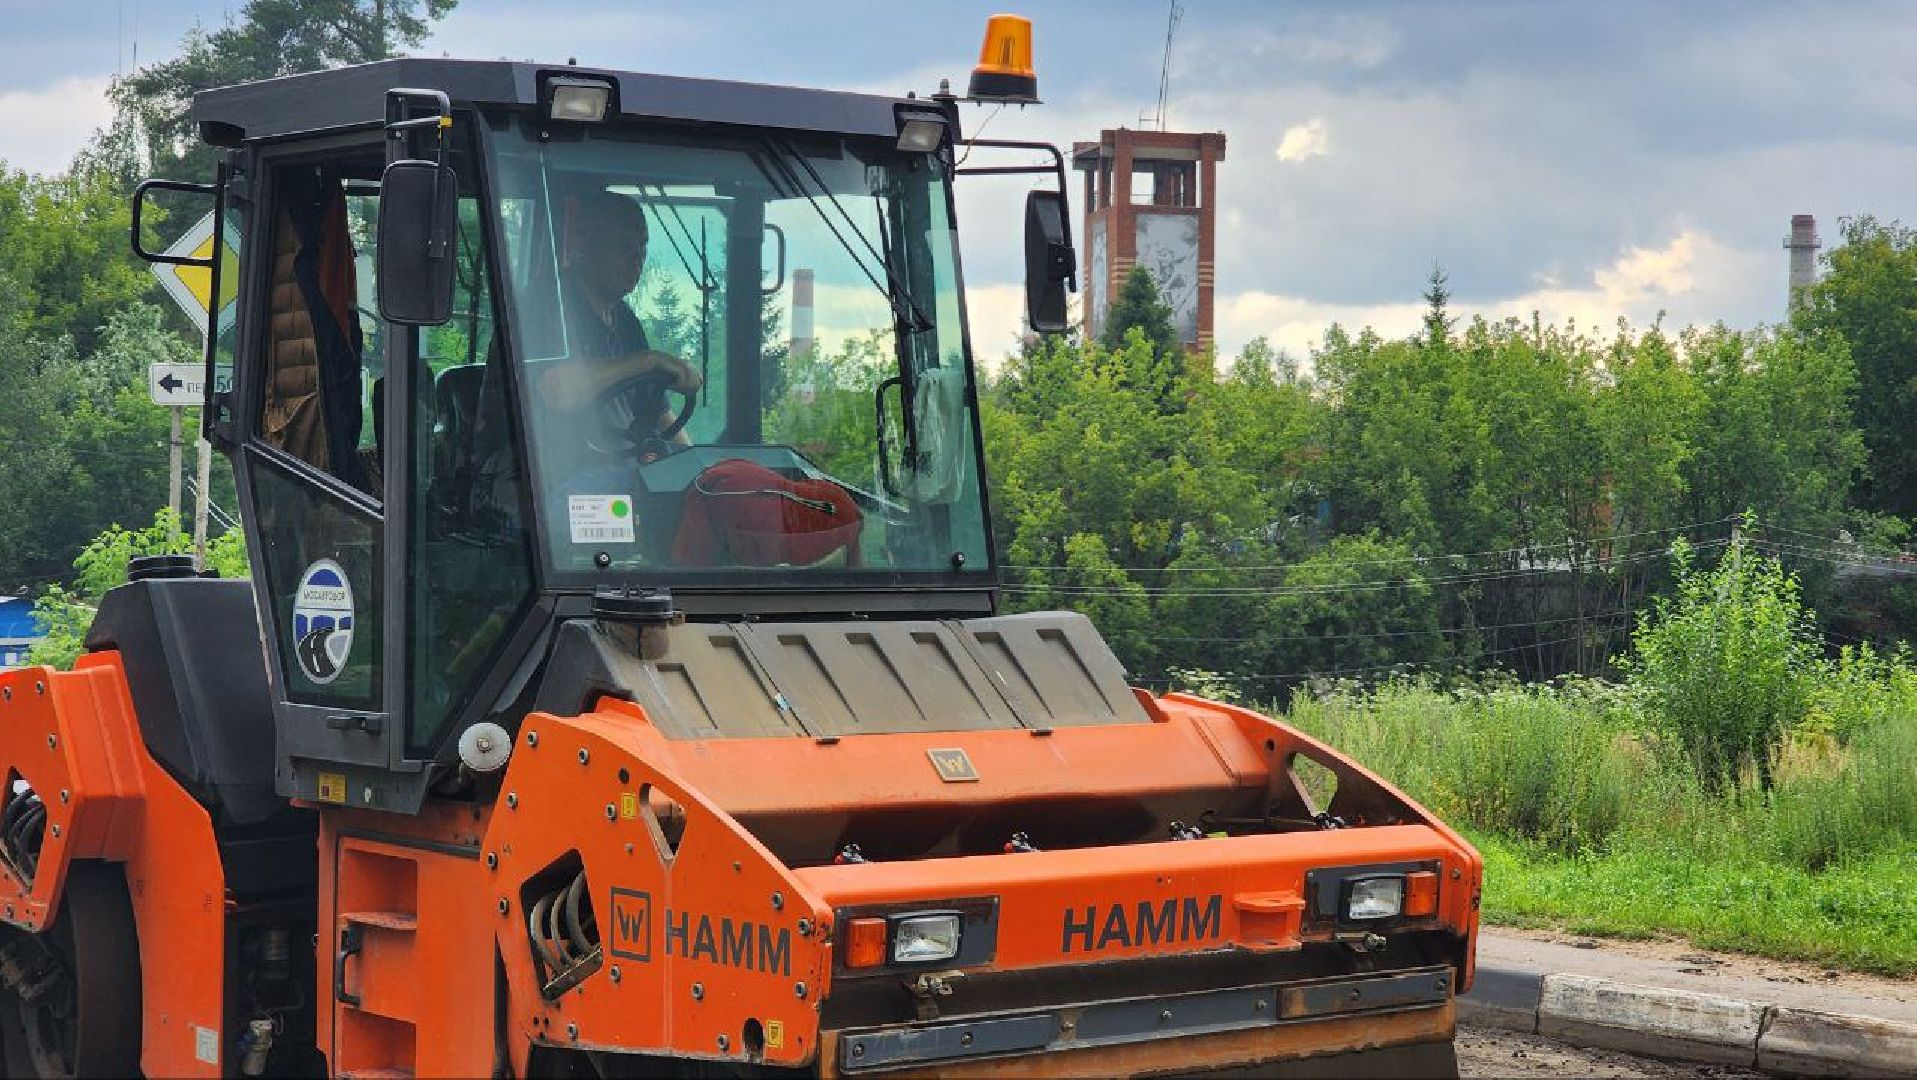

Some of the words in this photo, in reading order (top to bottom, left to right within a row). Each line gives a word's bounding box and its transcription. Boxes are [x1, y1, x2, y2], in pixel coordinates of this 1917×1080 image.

[187, 382, 206, 393] ПЕ
[665, 908, 791, 977] HAMM
[1062, 894, 1222, 952] HAMM
